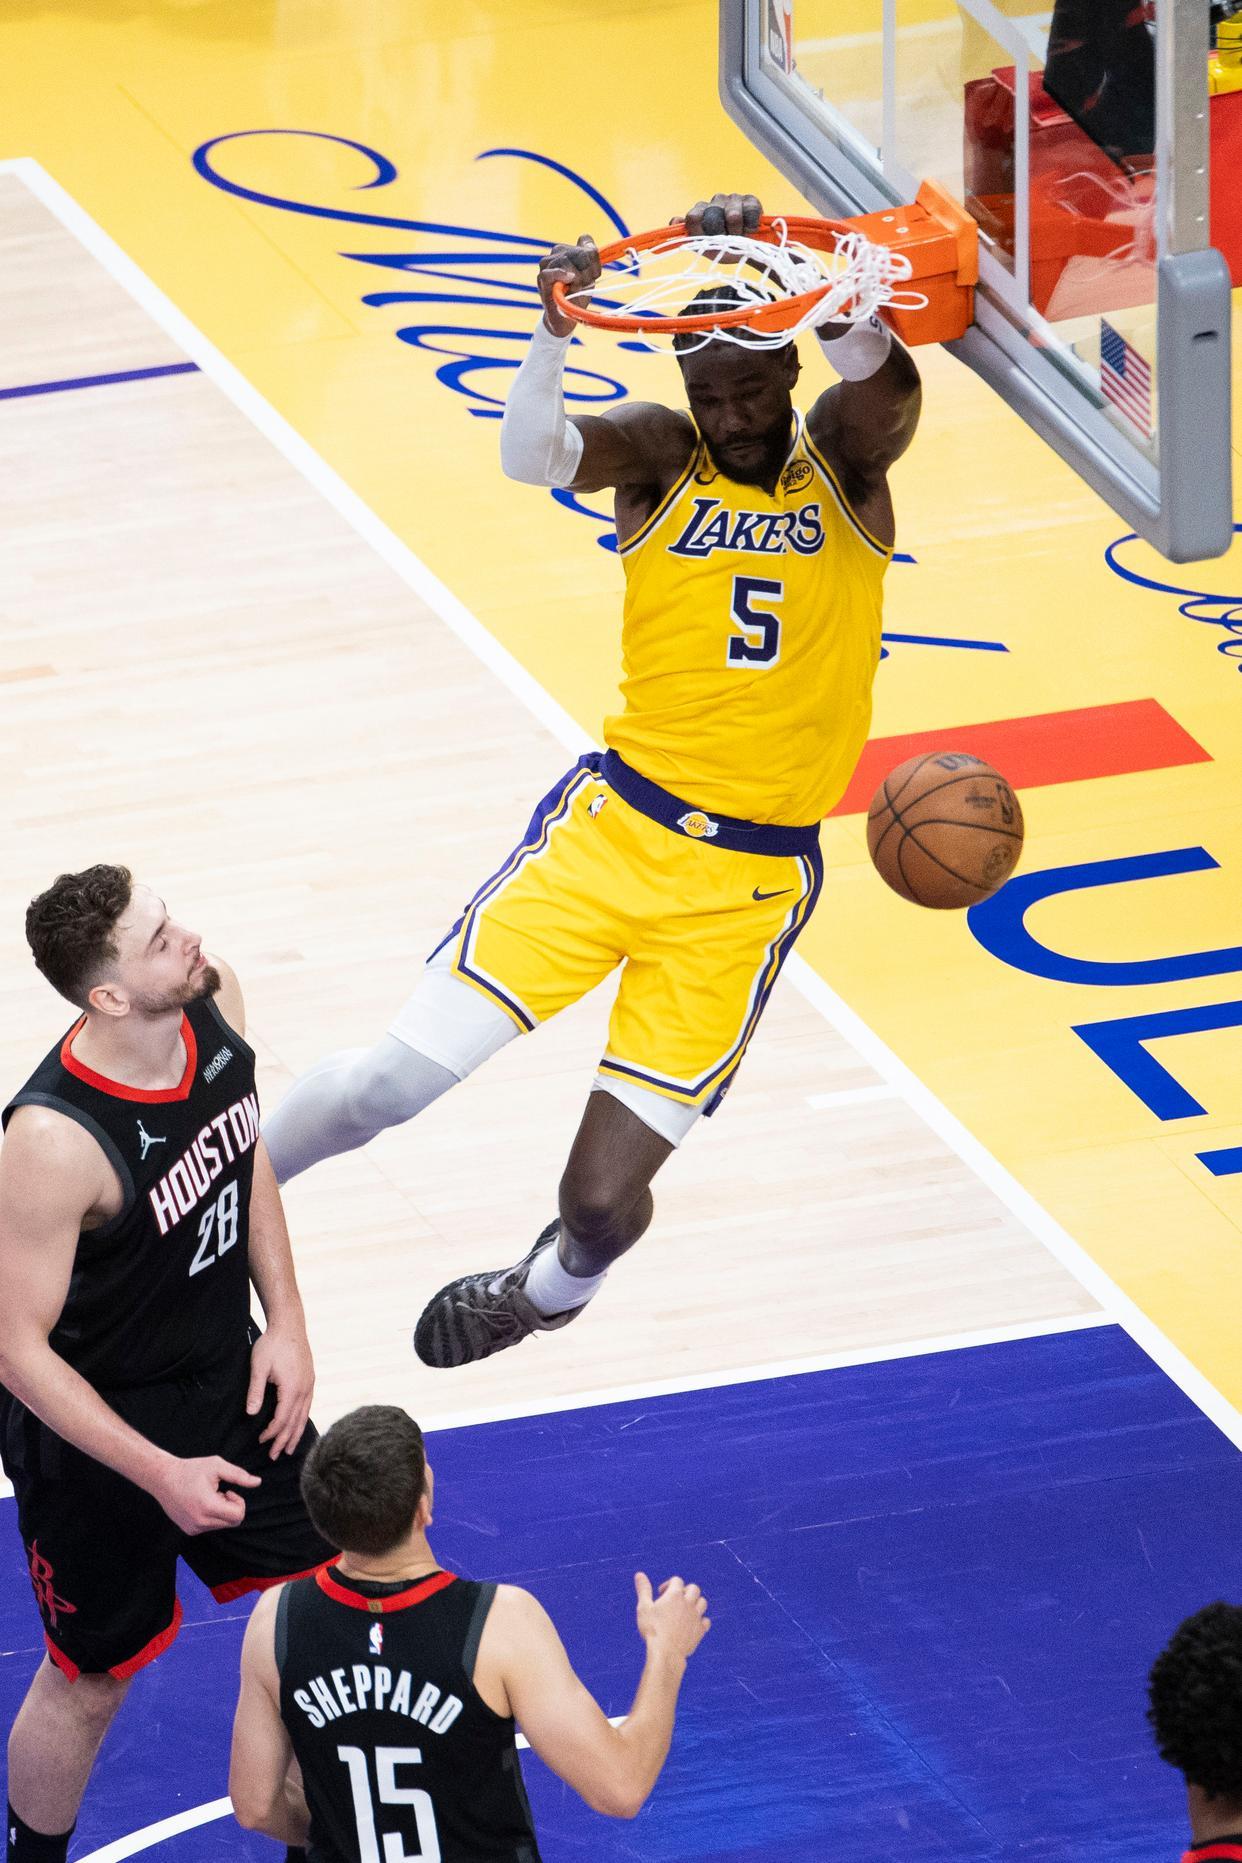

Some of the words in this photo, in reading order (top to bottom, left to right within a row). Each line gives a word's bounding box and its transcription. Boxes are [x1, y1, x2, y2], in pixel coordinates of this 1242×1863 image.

[665, 496, 825, 560] LAKERS
[726, 574, 784, 670] 5
[202, 1045, 229, 1079] MEMORIAL
[204, 1049, 233, 1084] HERMANN
[149, 1092, 260, 1236] HOUSTON
[188, 1179, 239, 1278] 28
[293, 1664, 464, 1735] SHEPPARD
[337, 1745, 442, 1863] 15
